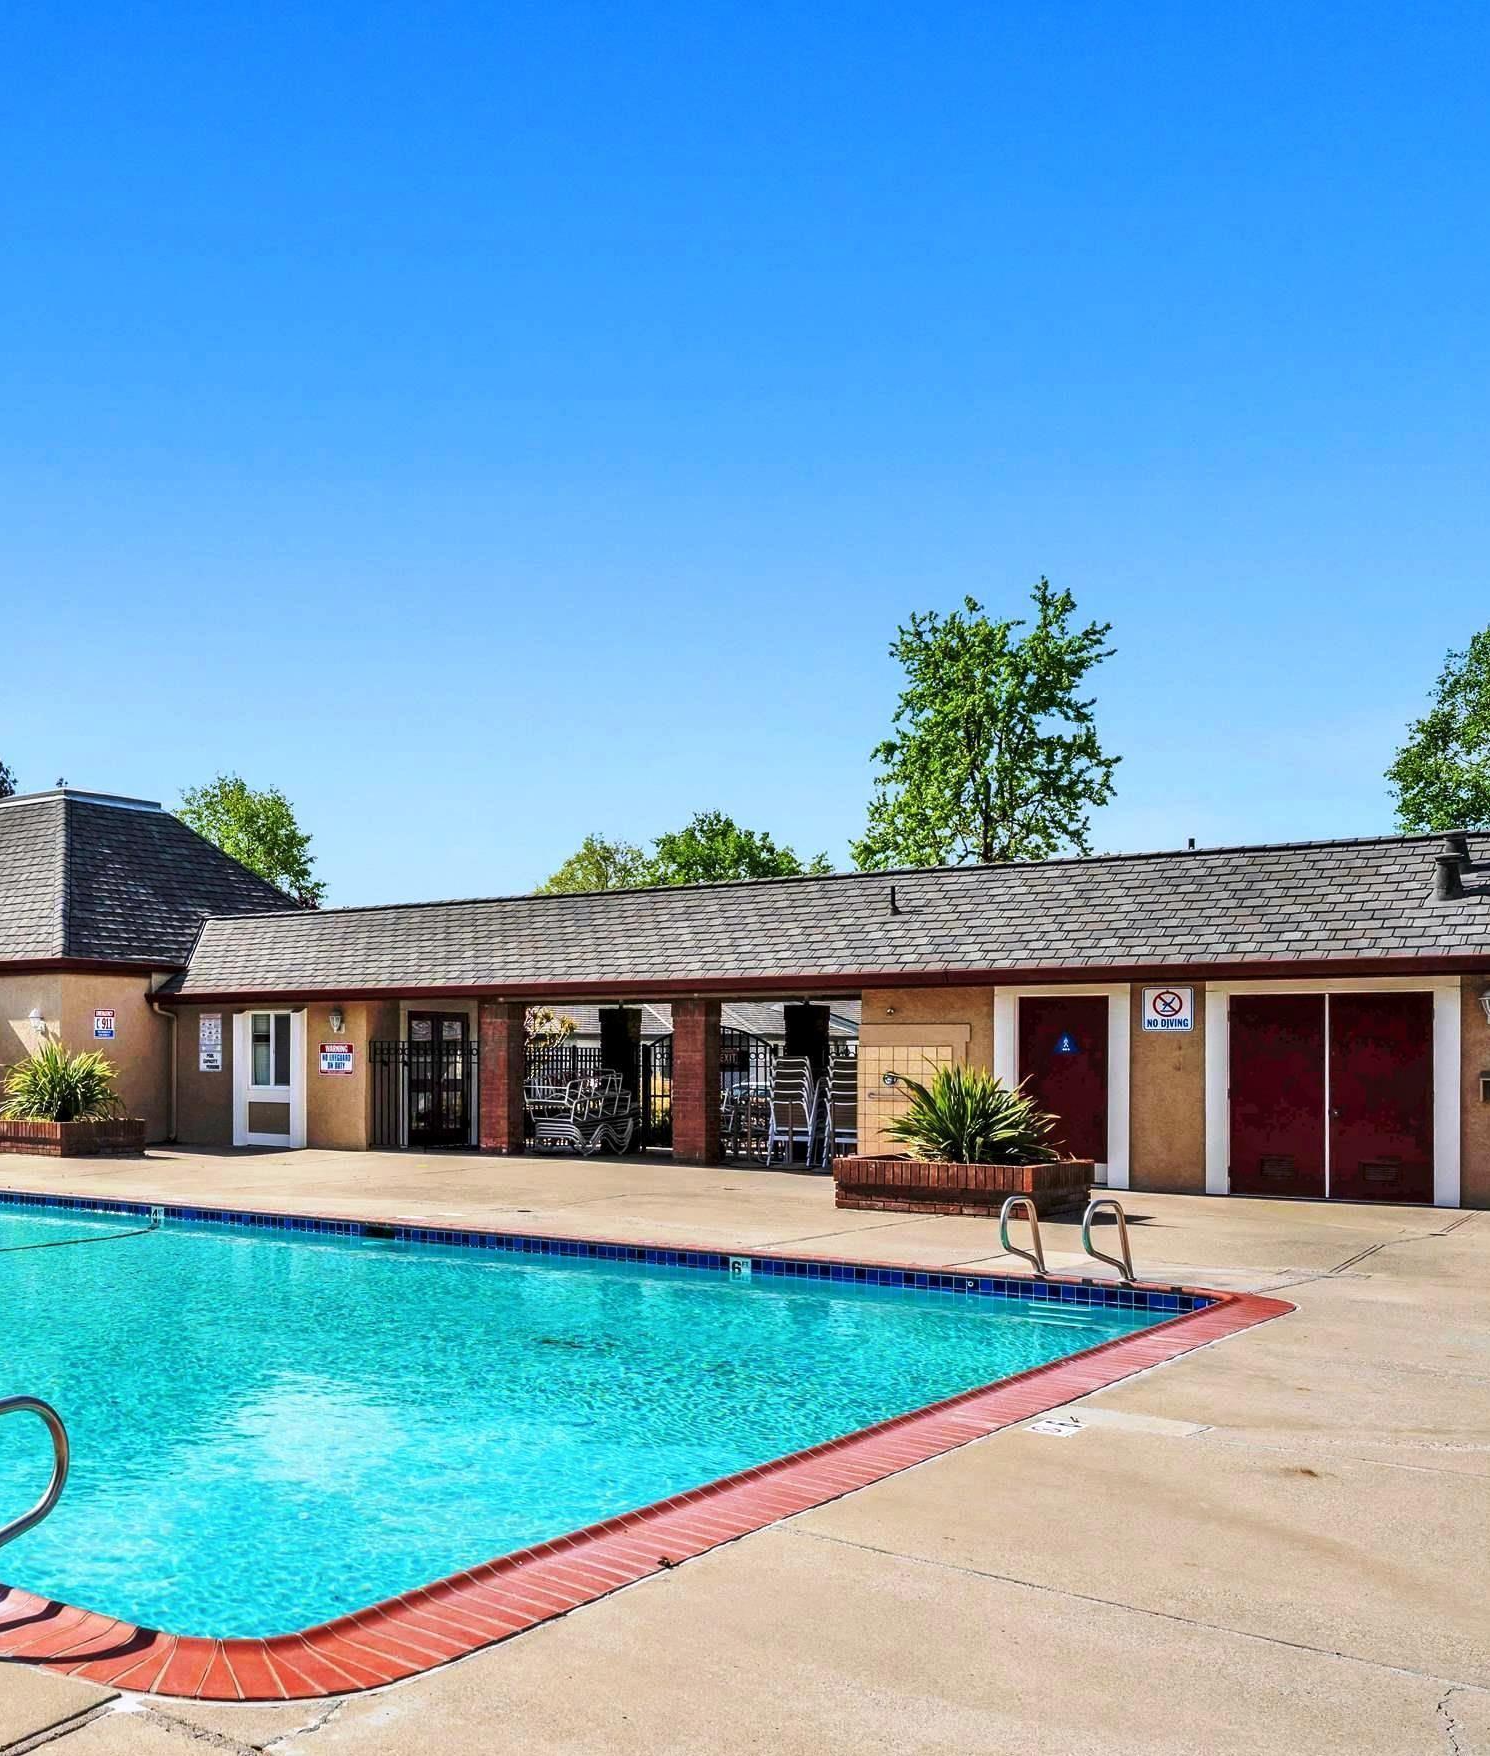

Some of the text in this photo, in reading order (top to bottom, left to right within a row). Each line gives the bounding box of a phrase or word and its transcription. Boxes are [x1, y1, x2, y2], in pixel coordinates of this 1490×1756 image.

[102, 1018, 112, 1029] 911
[1147, 1019, 1189, 1028] NO DIVING
[720, 1053, 736, 1064] EXIT
[731, 1260, 742, 1272] 6
